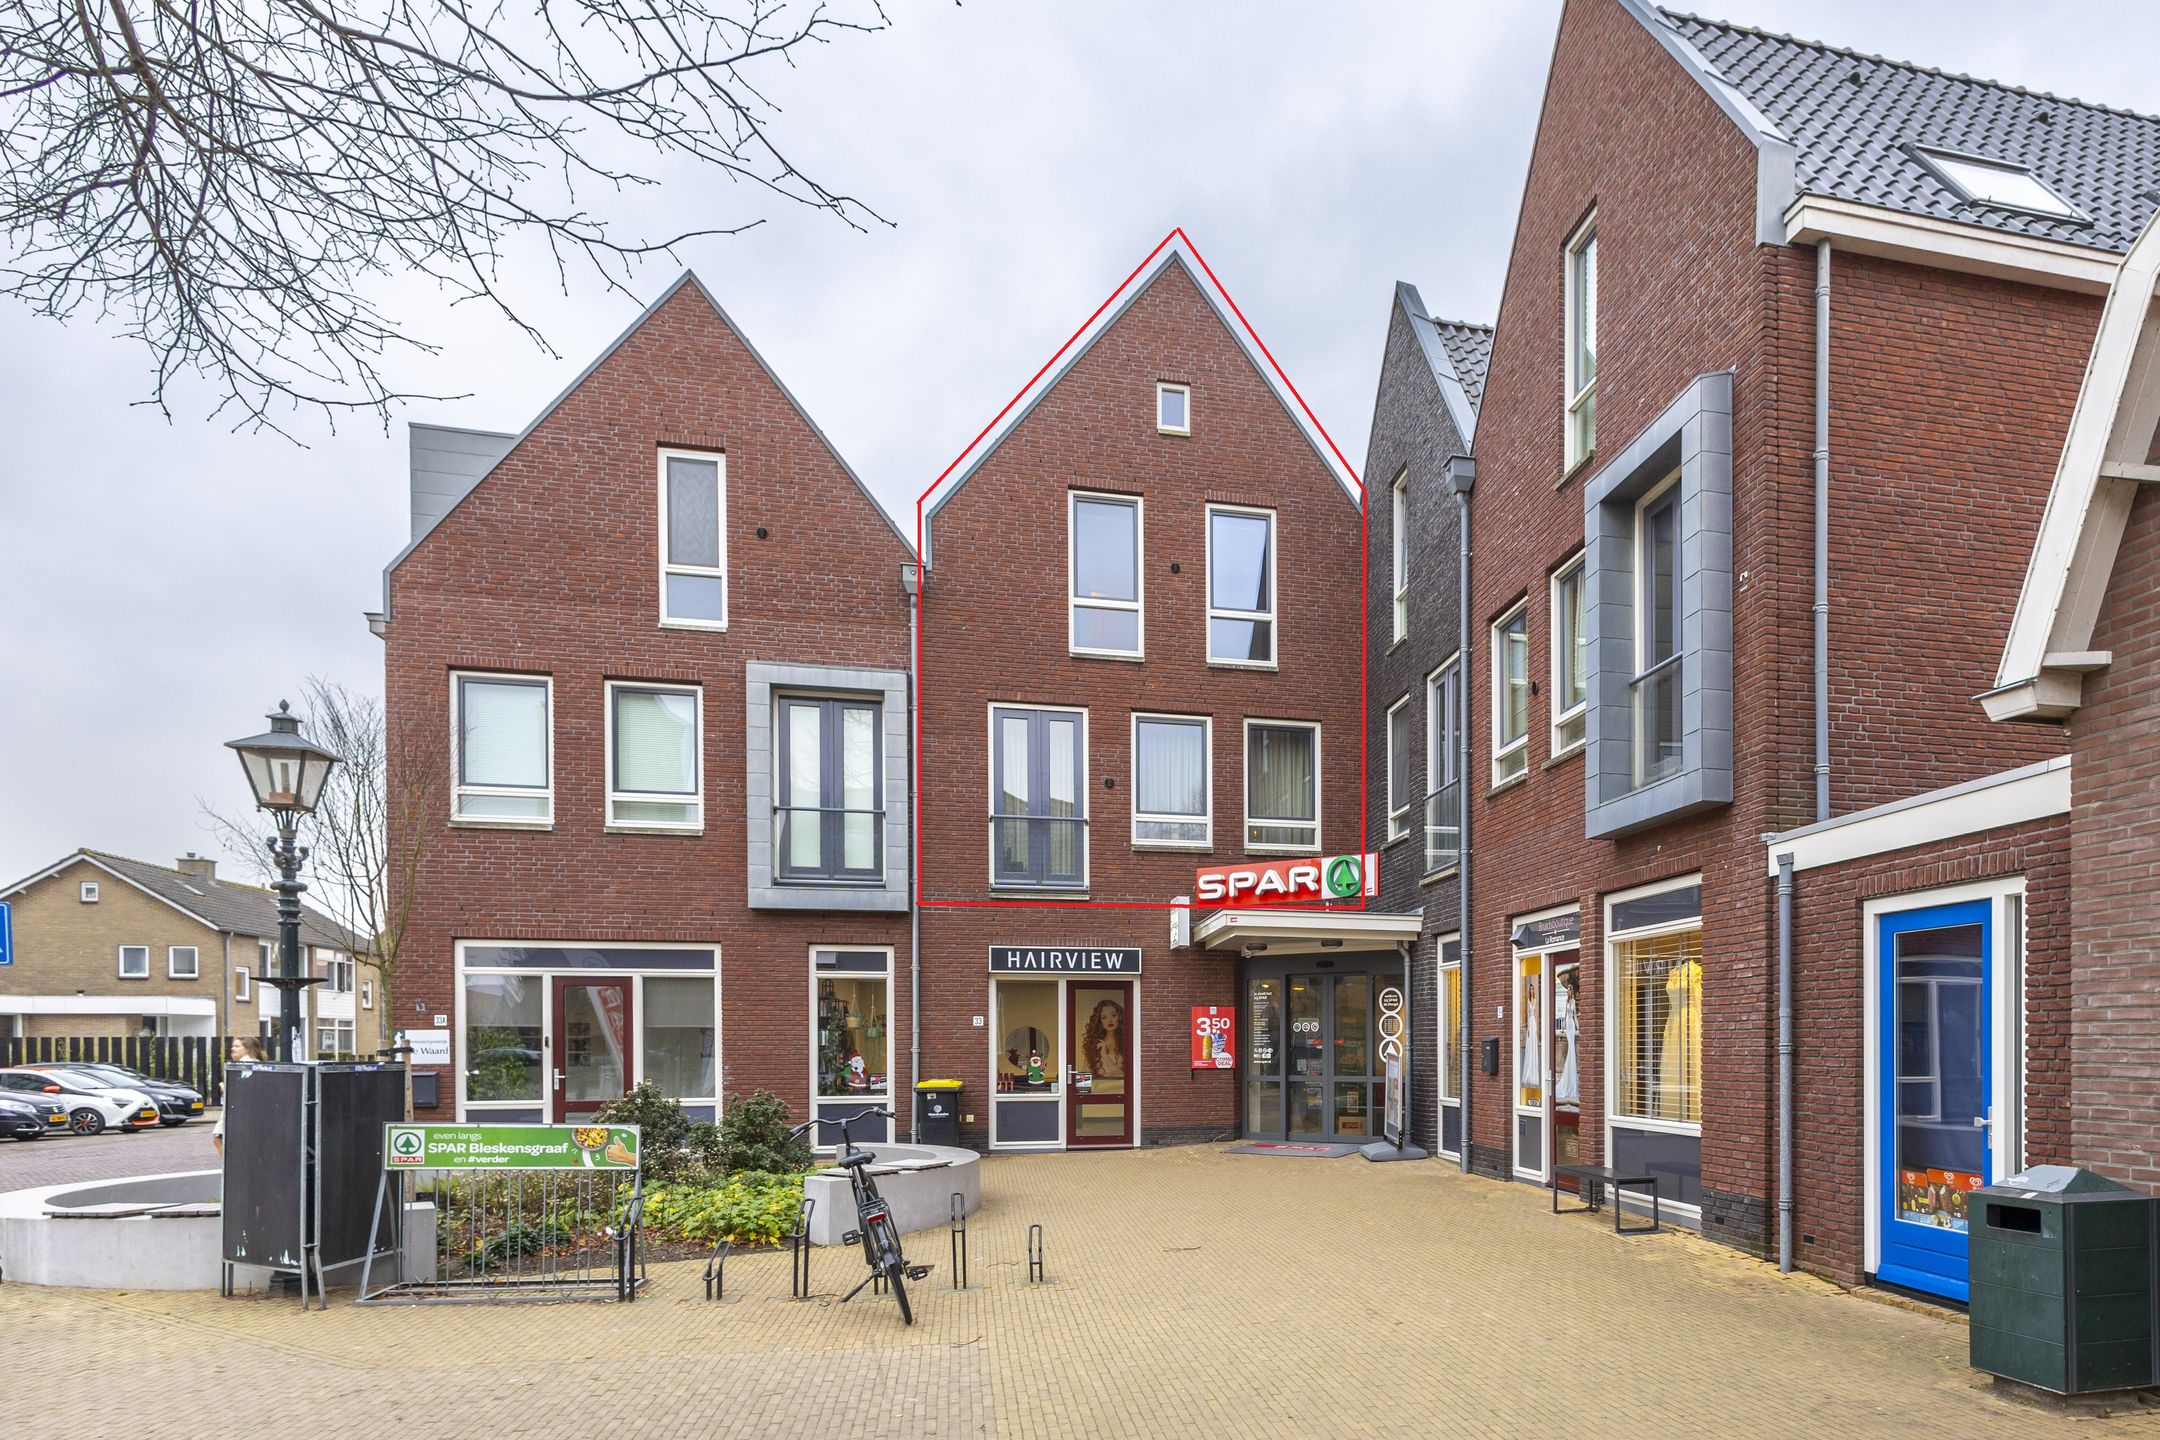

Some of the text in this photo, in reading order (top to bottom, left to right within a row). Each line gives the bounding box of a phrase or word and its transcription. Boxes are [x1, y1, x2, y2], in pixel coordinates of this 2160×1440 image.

[1198, 865, 1319, 900] SPAR
[1538, 916, 1575, 931] Bruidsboutique
[1550, 934, 1565, 944] Romance
[1007, 951, 1124, 969] HAIRVIEW
[974, 1017, 982, 1025] 33
[420, 1046, 449, 1055] Waard
[433, 1132, 482, 1142] even langs
[428, 1142, 569, 1156] SPAR Bleskensgraaf
[453, 1155, 509, 1164] en #verder
